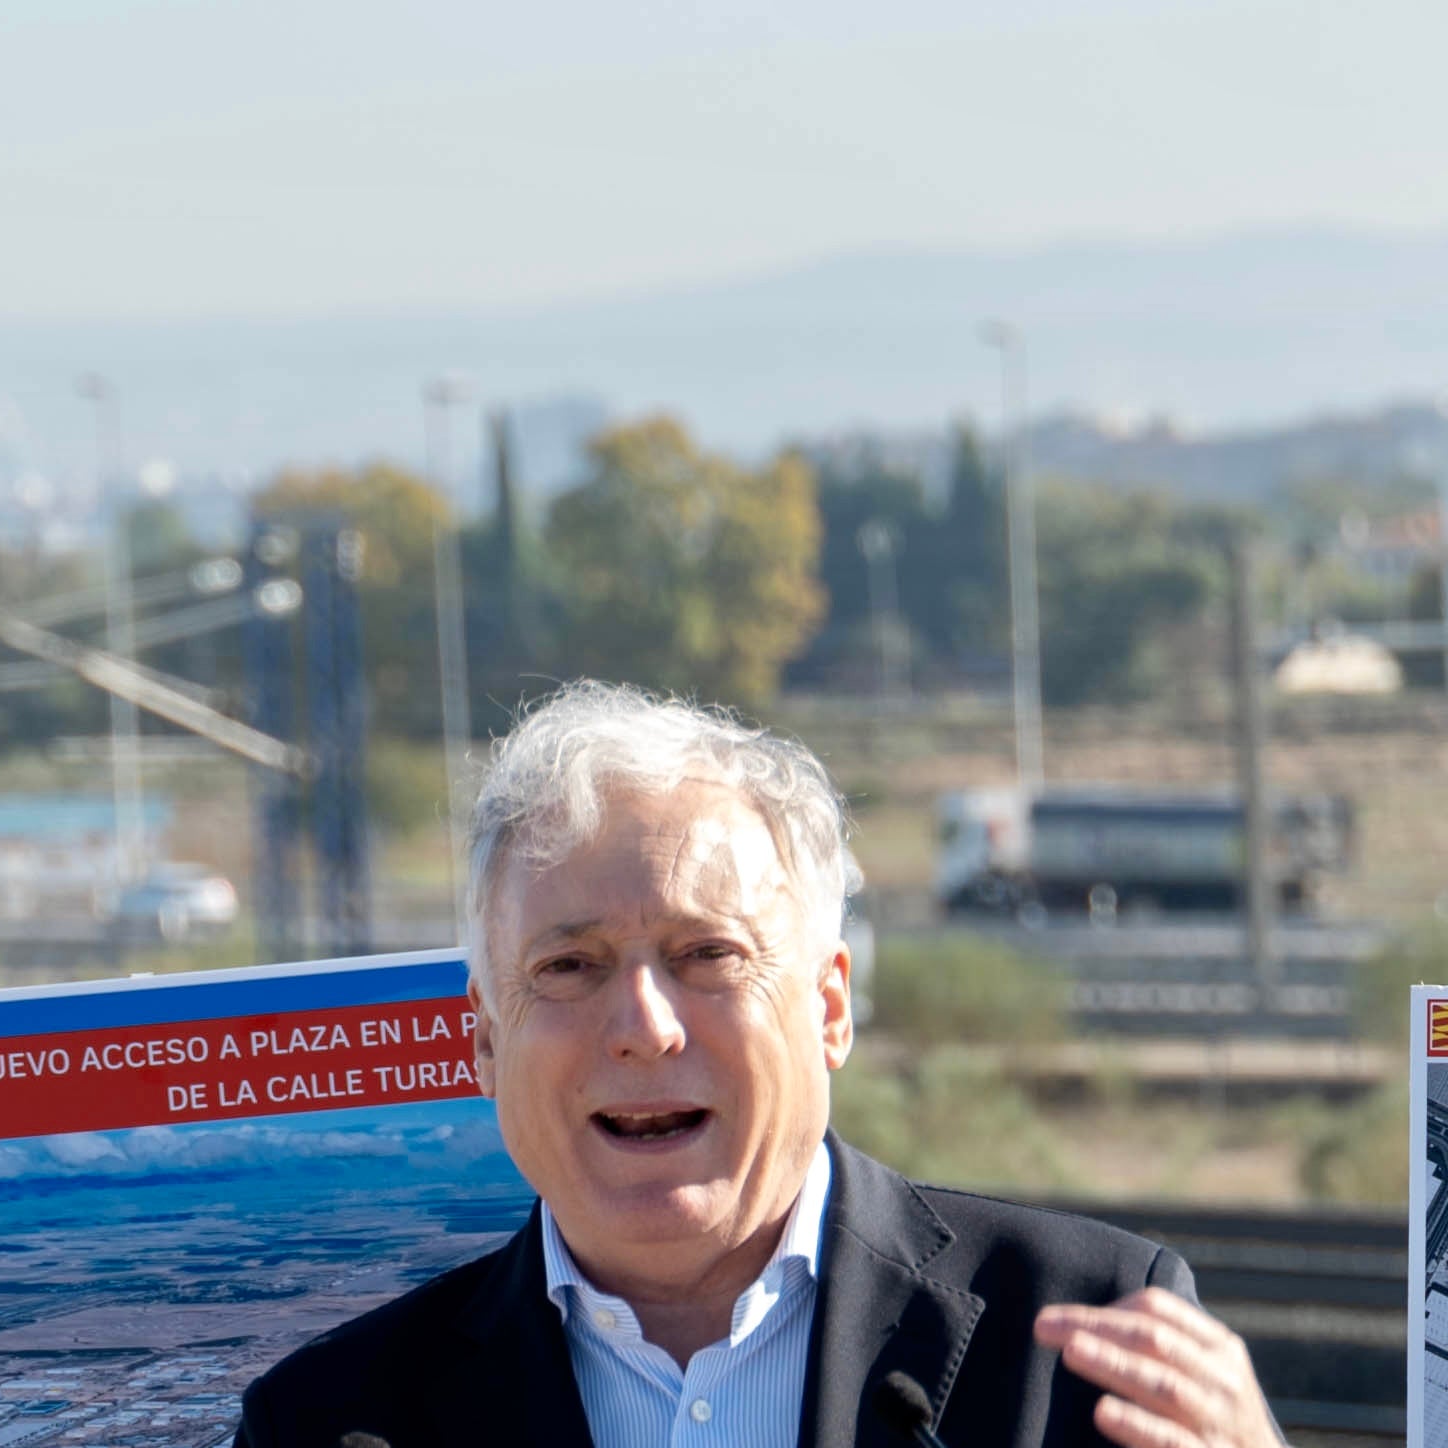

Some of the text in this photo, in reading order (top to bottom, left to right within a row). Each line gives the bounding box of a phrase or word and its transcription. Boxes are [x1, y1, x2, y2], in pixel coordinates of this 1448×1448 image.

[80, 1036, 209, 1072] ACCESO
[219, 1033, 242, 1061] A
[251, 1024, 352, 1057] PLAZA
[360, 1019, 403, 1049] EN
[412, 1014, 452, 1044] LA
[167, 1058, 480, 1112] DE LA CALLE TURIA
